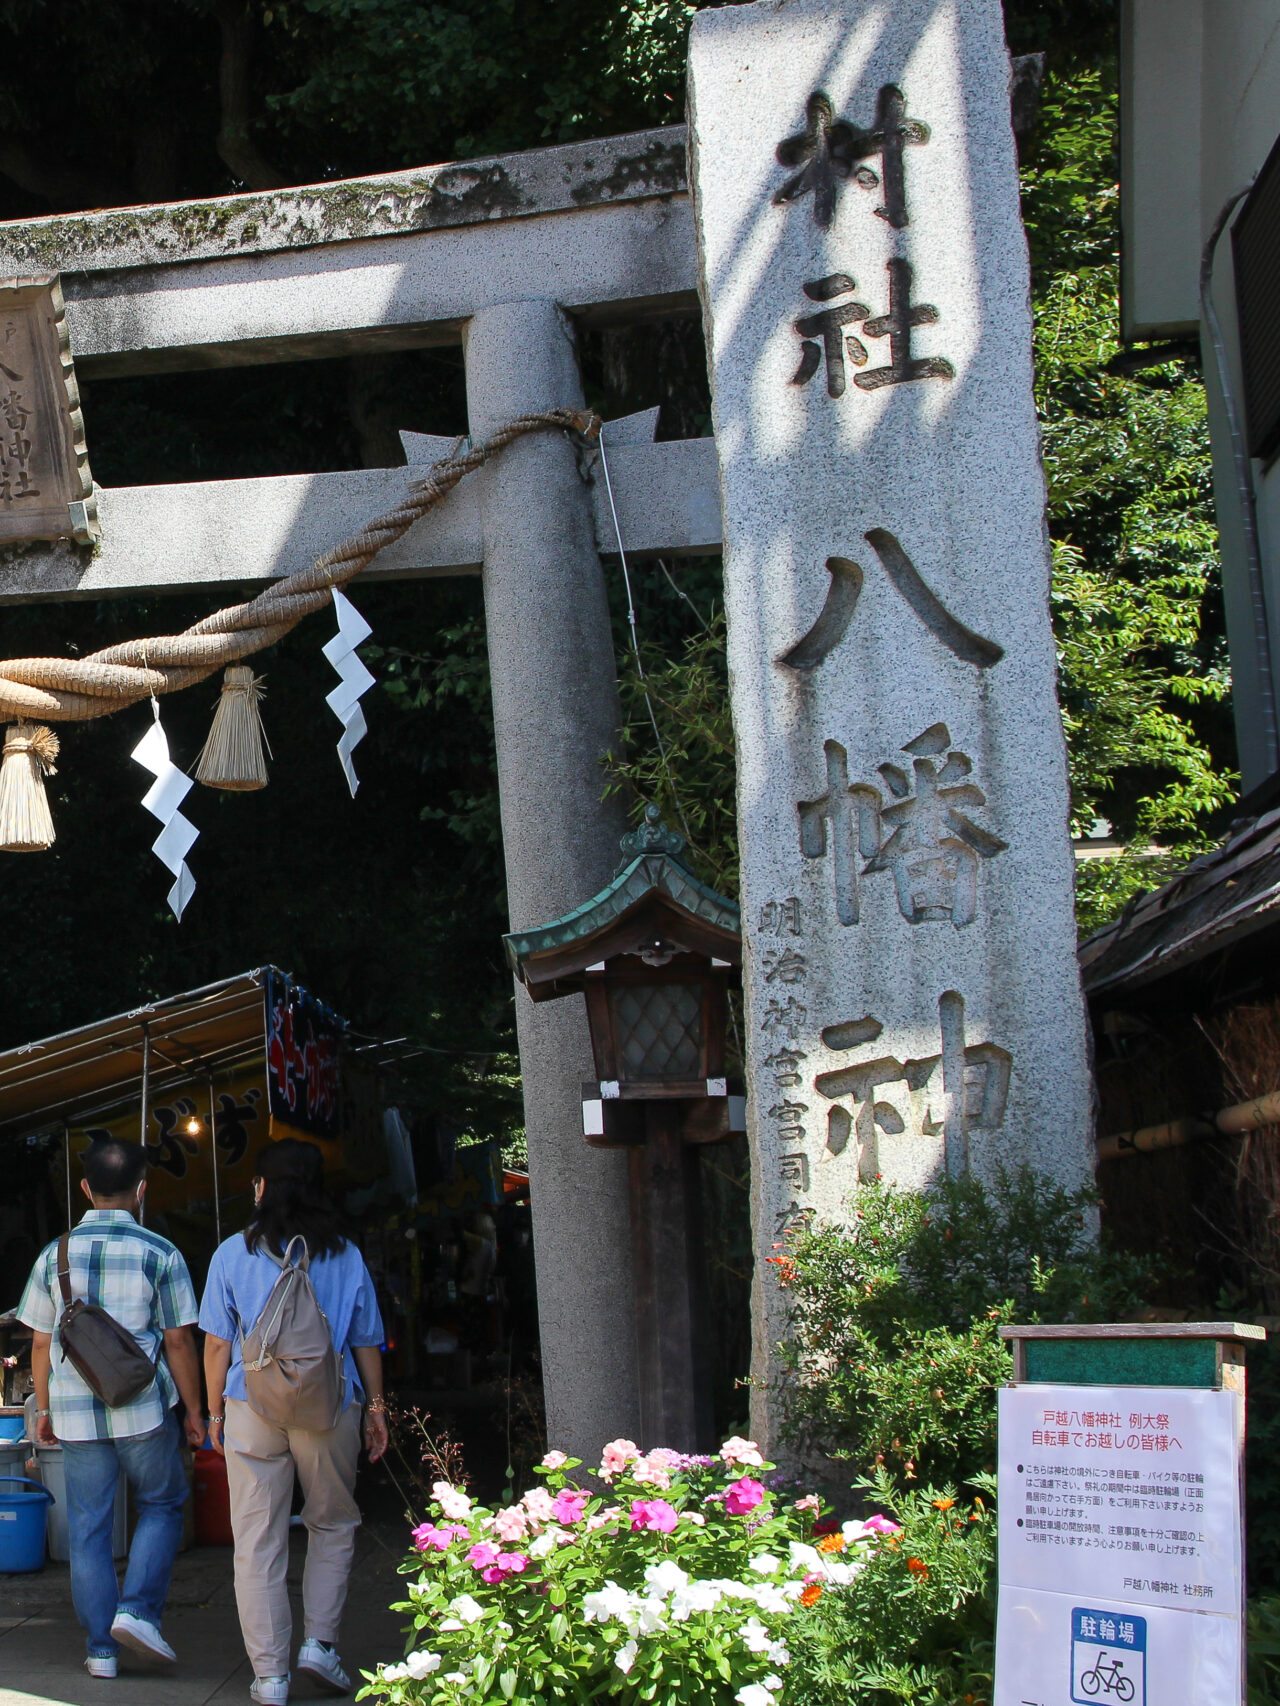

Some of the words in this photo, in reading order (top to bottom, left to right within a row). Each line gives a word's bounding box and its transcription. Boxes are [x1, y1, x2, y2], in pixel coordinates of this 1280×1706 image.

[1043, 1410, 1122, 1428] 戸越八幡神社
[1129, 1412, 1170, 1431] 例大祭
[1032, 1430, 1183, 1452] 自転車でお越しの皆様へ
[1123, 1577, 1179, 1595] 戸越八幡神社
[1183, 1584, 1213, 1599] 社務所
[1080, 1615, 1135, 1645] 駐輪場
